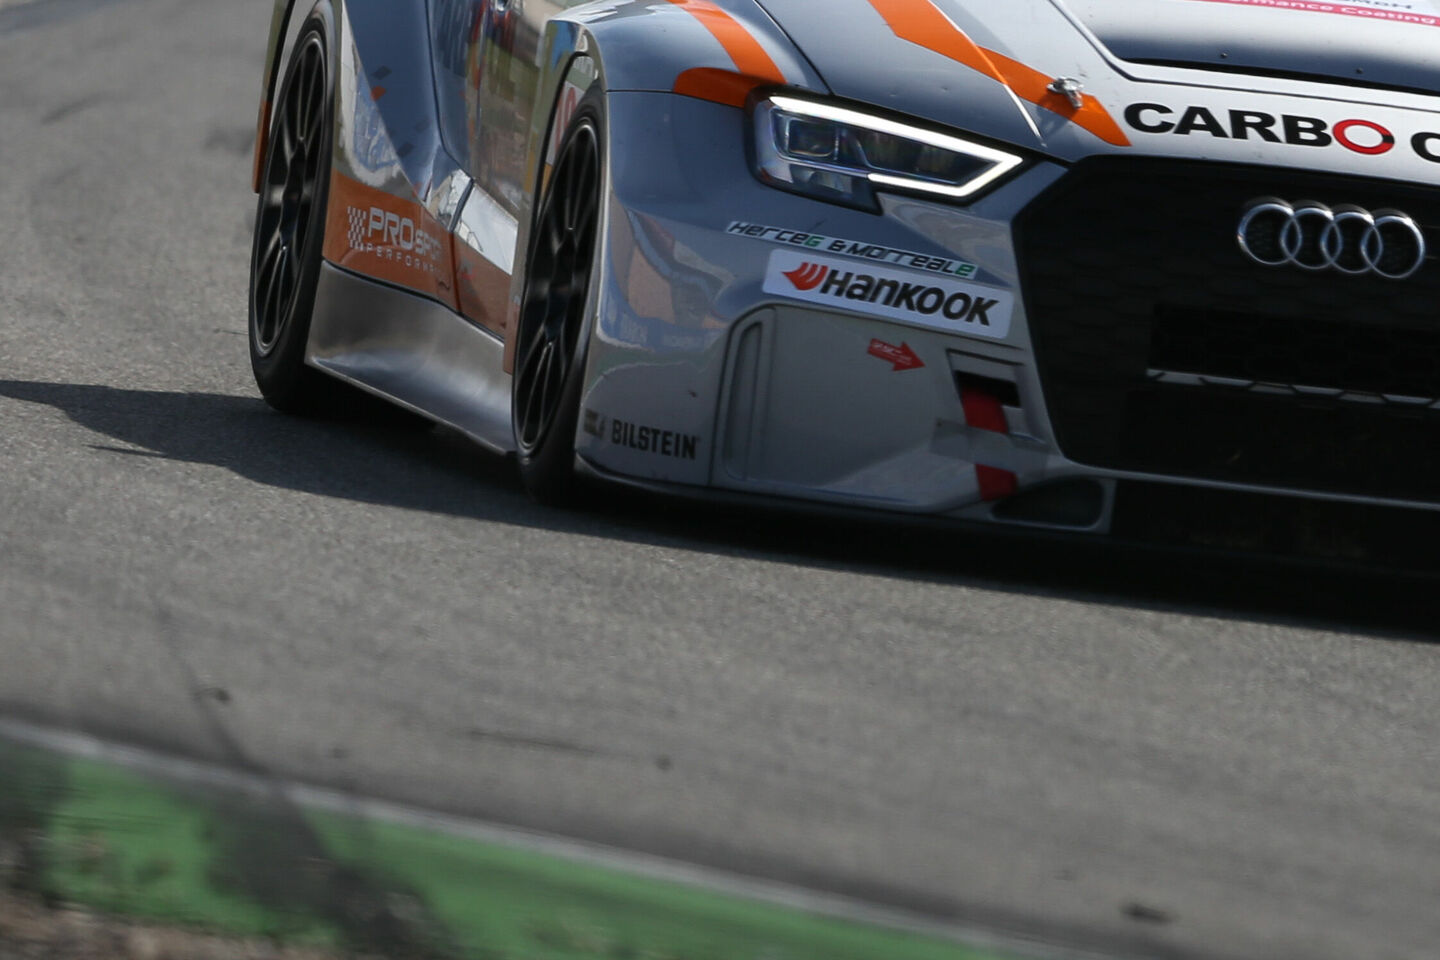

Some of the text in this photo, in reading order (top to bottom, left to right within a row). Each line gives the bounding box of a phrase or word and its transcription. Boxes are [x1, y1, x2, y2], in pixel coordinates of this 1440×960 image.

[1341, 7, 1438, 24] Coating
[1124, 102, 1395, 155] CARBO
[827, 240, 847, 252] &
[612, 419, 698, 460] BILSTEIN
